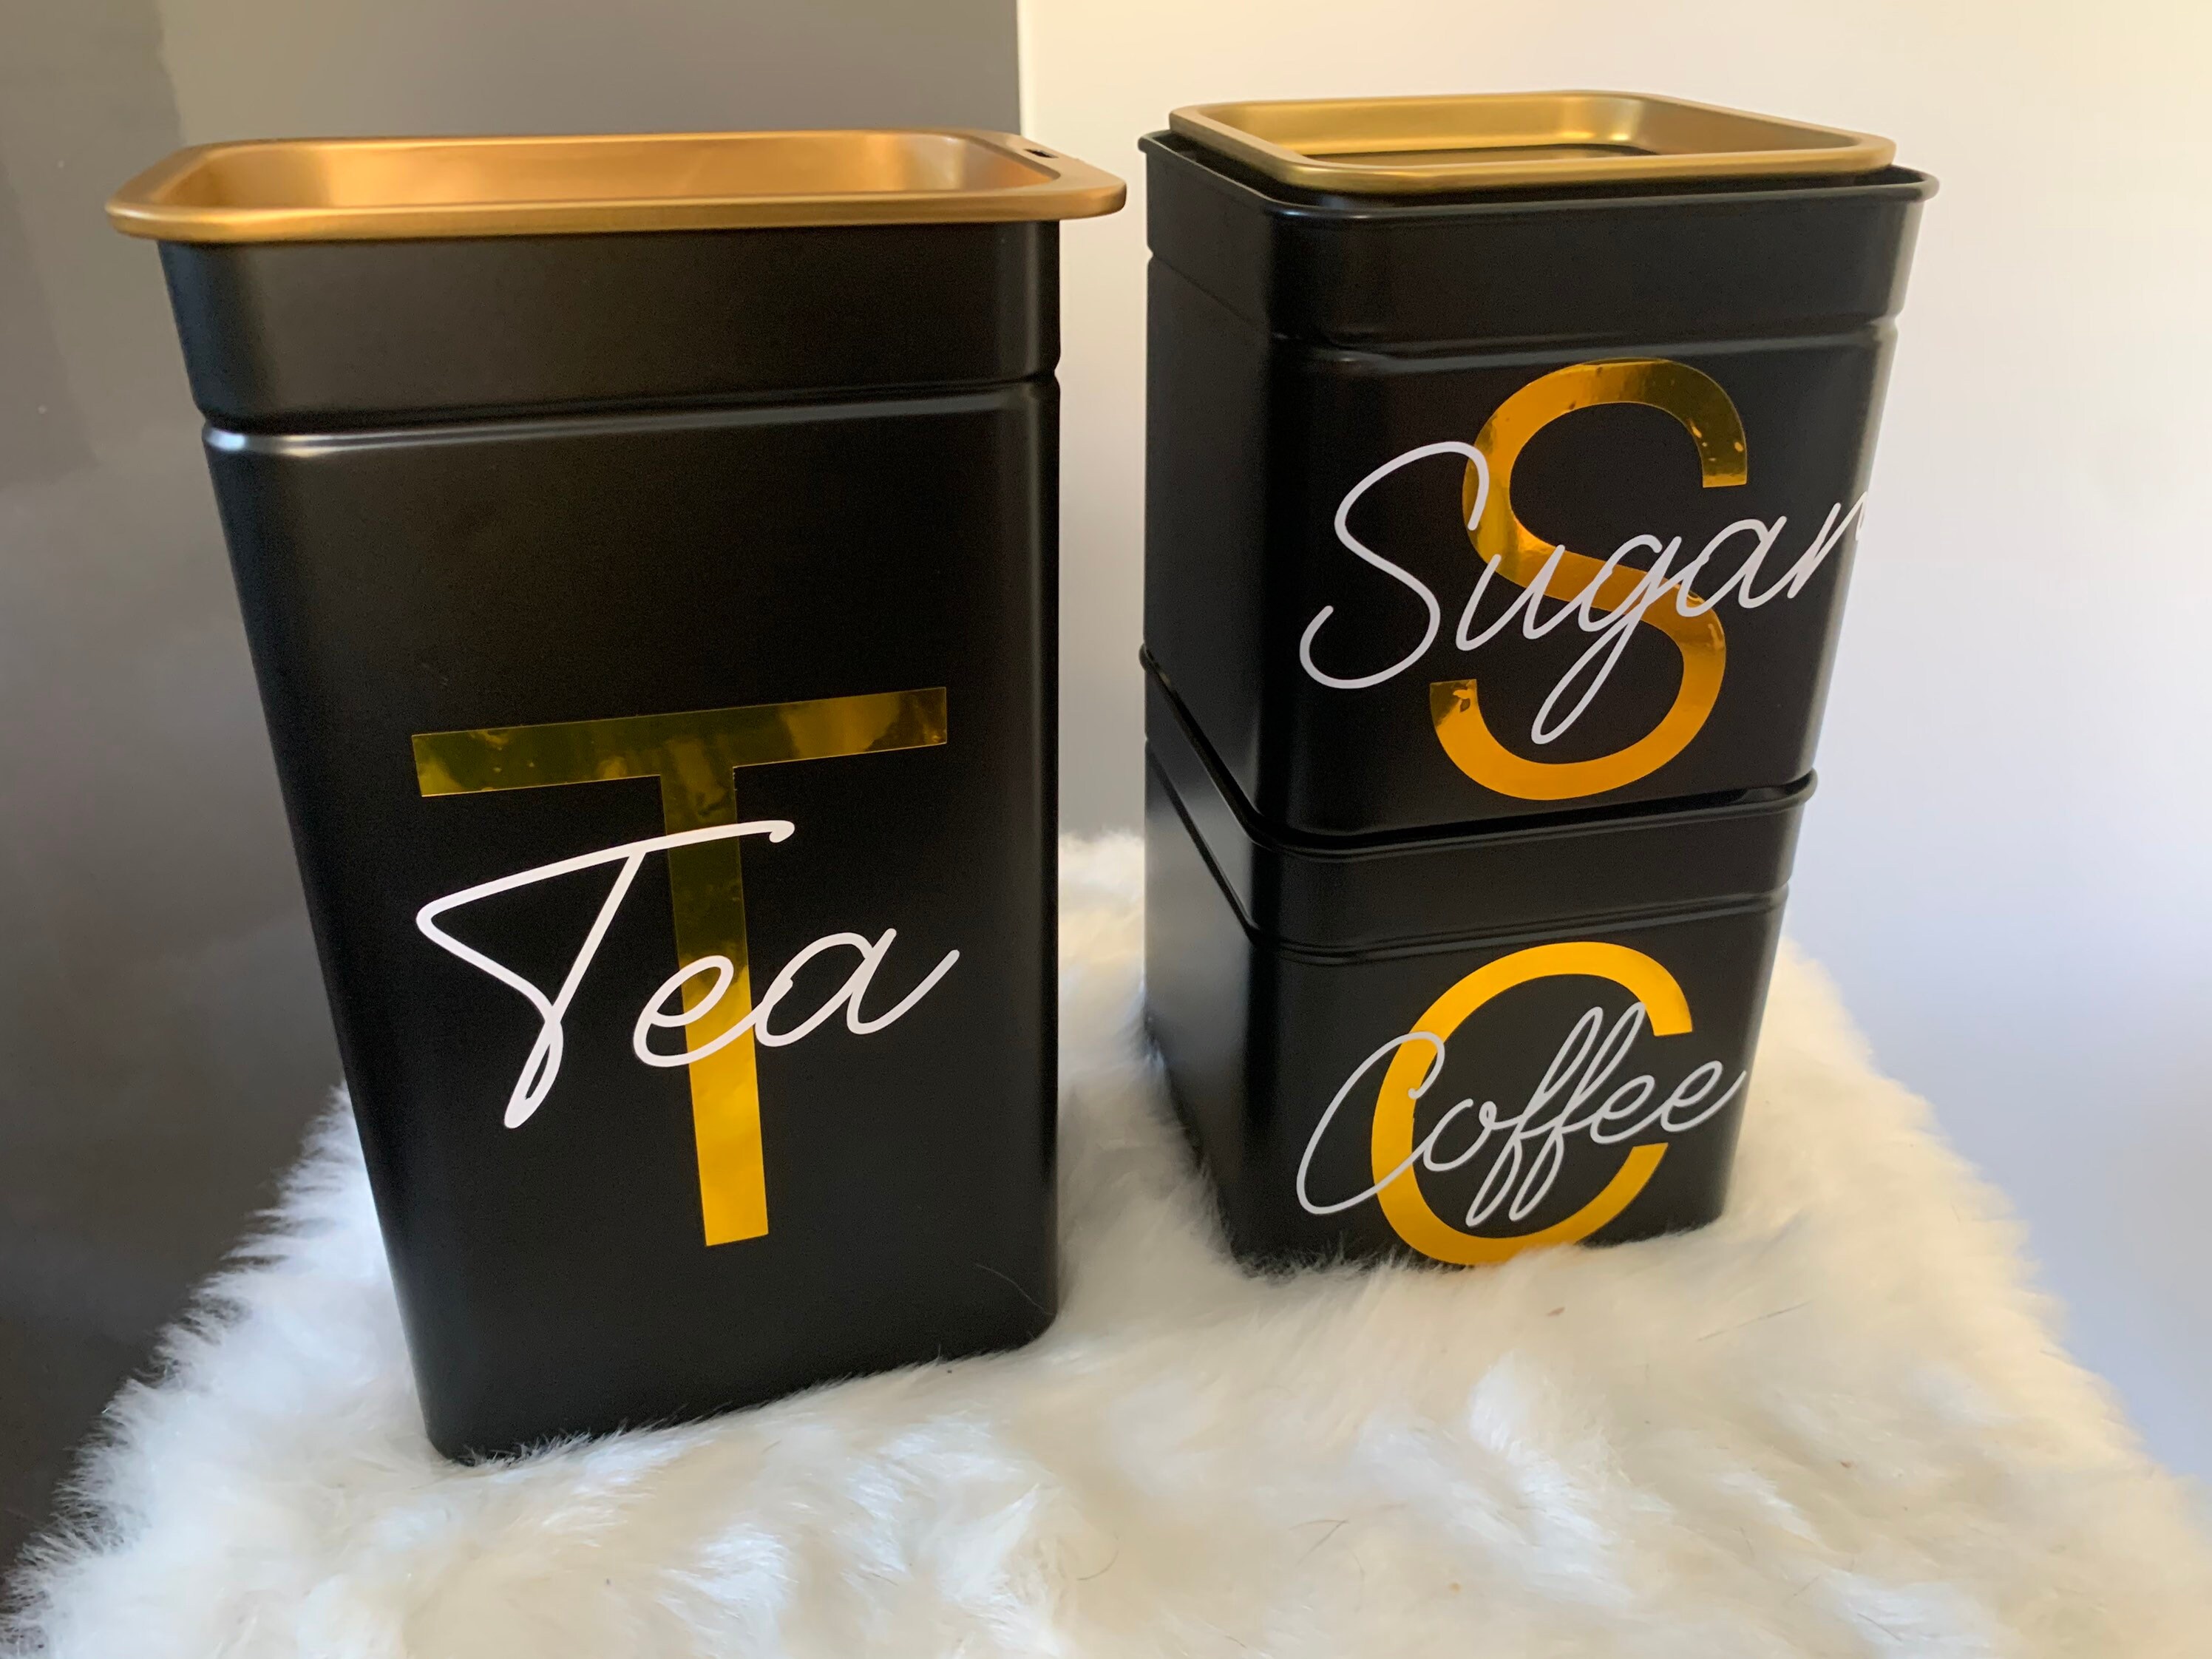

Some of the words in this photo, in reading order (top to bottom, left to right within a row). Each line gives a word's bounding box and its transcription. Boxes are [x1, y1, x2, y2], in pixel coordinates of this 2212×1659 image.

[1300, 441, 1867, 744] Sugar
[1429, 358, 1748, 801] S
[411, 687, 948, 1246] T
[416, 821, 960, 1128] Tea
[1297, 1002, 1746, 1227] Coffee
[1371, 941, 1692, 1267] C
